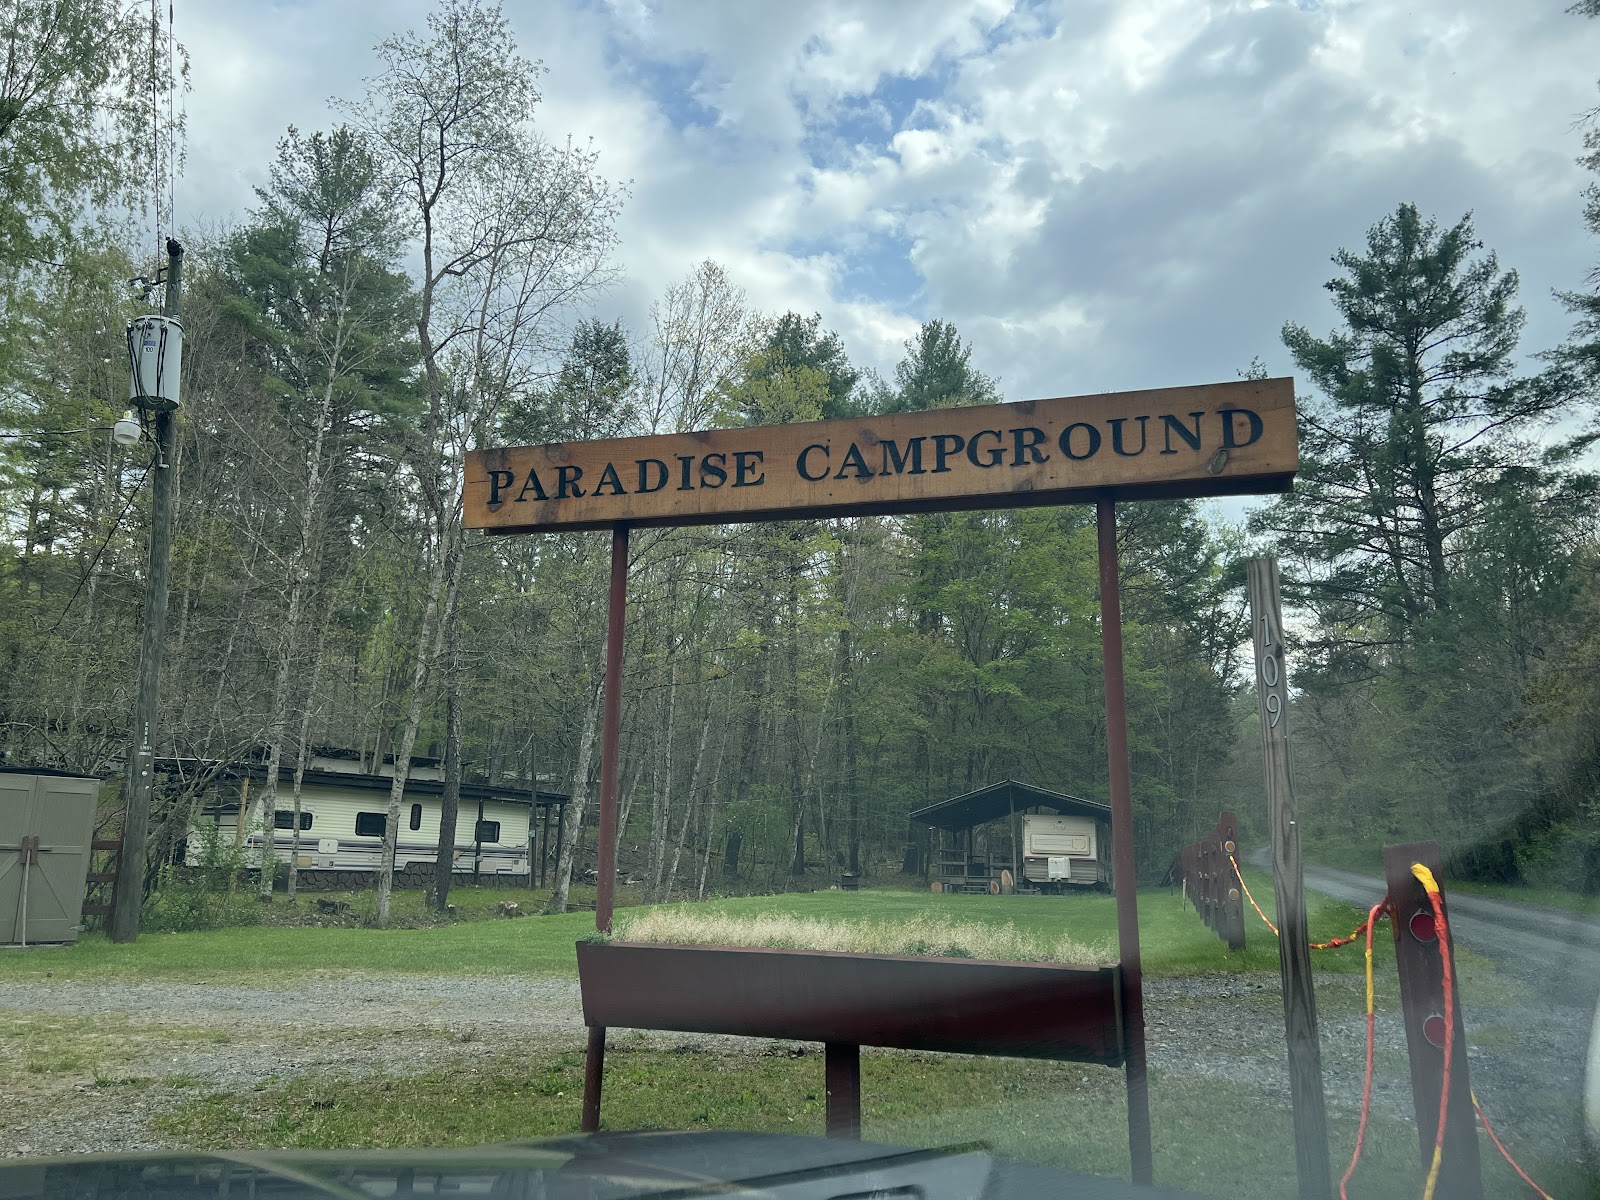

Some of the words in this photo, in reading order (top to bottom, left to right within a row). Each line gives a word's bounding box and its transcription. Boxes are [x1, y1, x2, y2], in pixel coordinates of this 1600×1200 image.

[487, 451, 765, 506] PARADISE
[796, 408, 1264, 481] CAMPGROUND
[1260, 613, 1282, 728] 109
